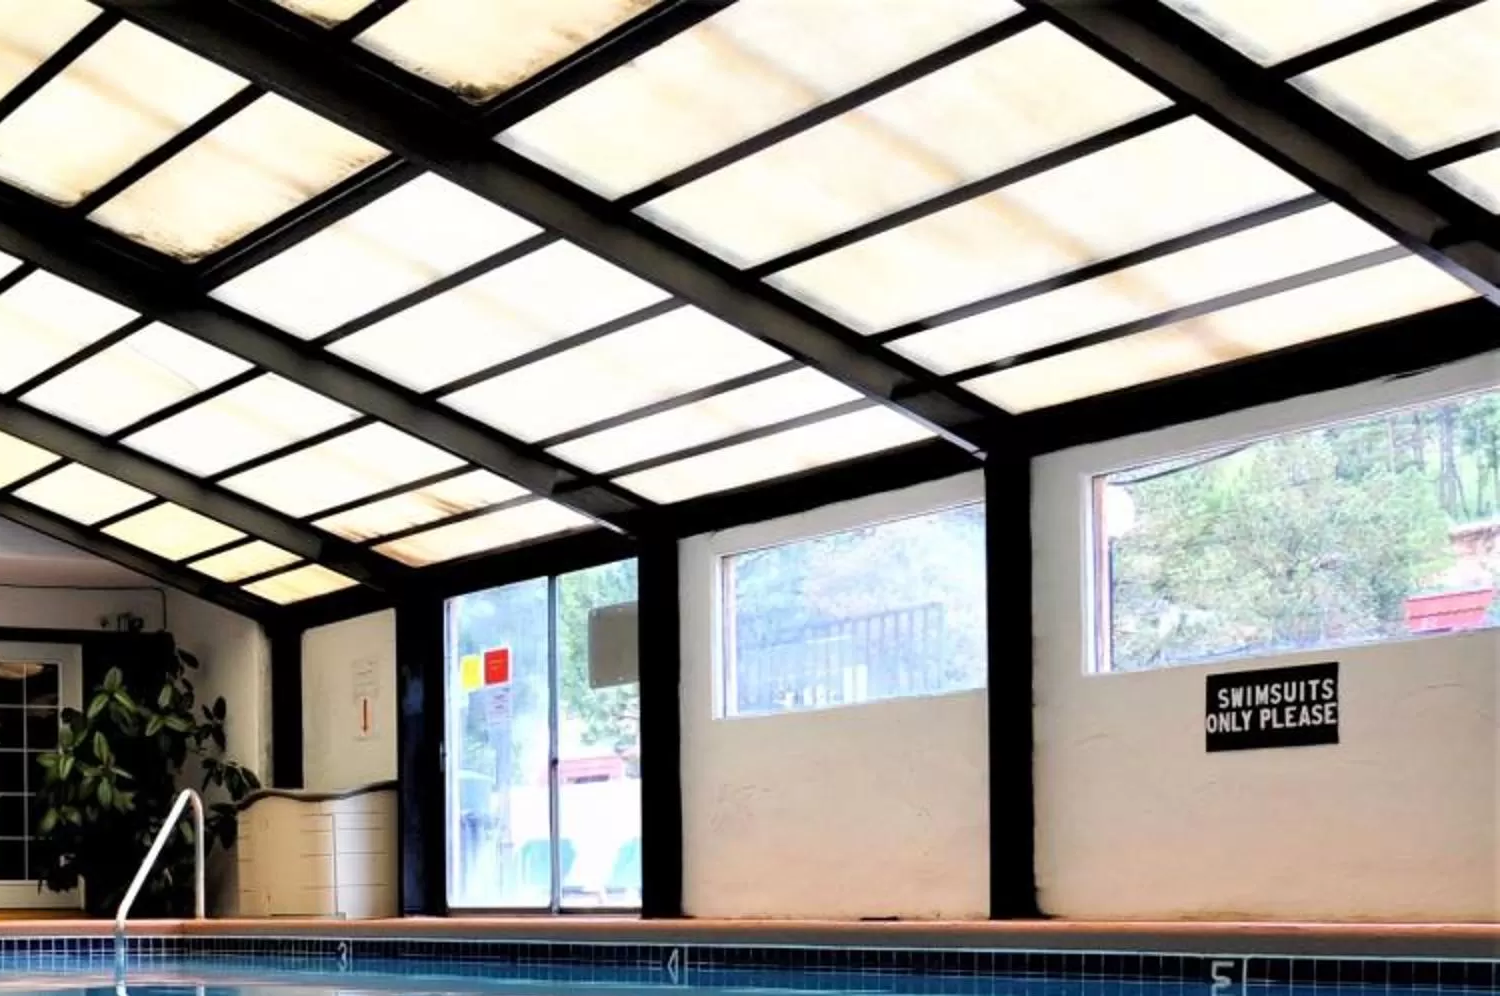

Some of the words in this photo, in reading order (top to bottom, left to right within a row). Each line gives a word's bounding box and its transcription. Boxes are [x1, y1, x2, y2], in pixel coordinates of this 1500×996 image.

[1217, 678, 1335, 709] SWIMSUITS
[1206, 709, 1253, 734] ONLY
[1259, 702, 1337, 730] PLEASE
[1211, 960, 1235, 992] 5
